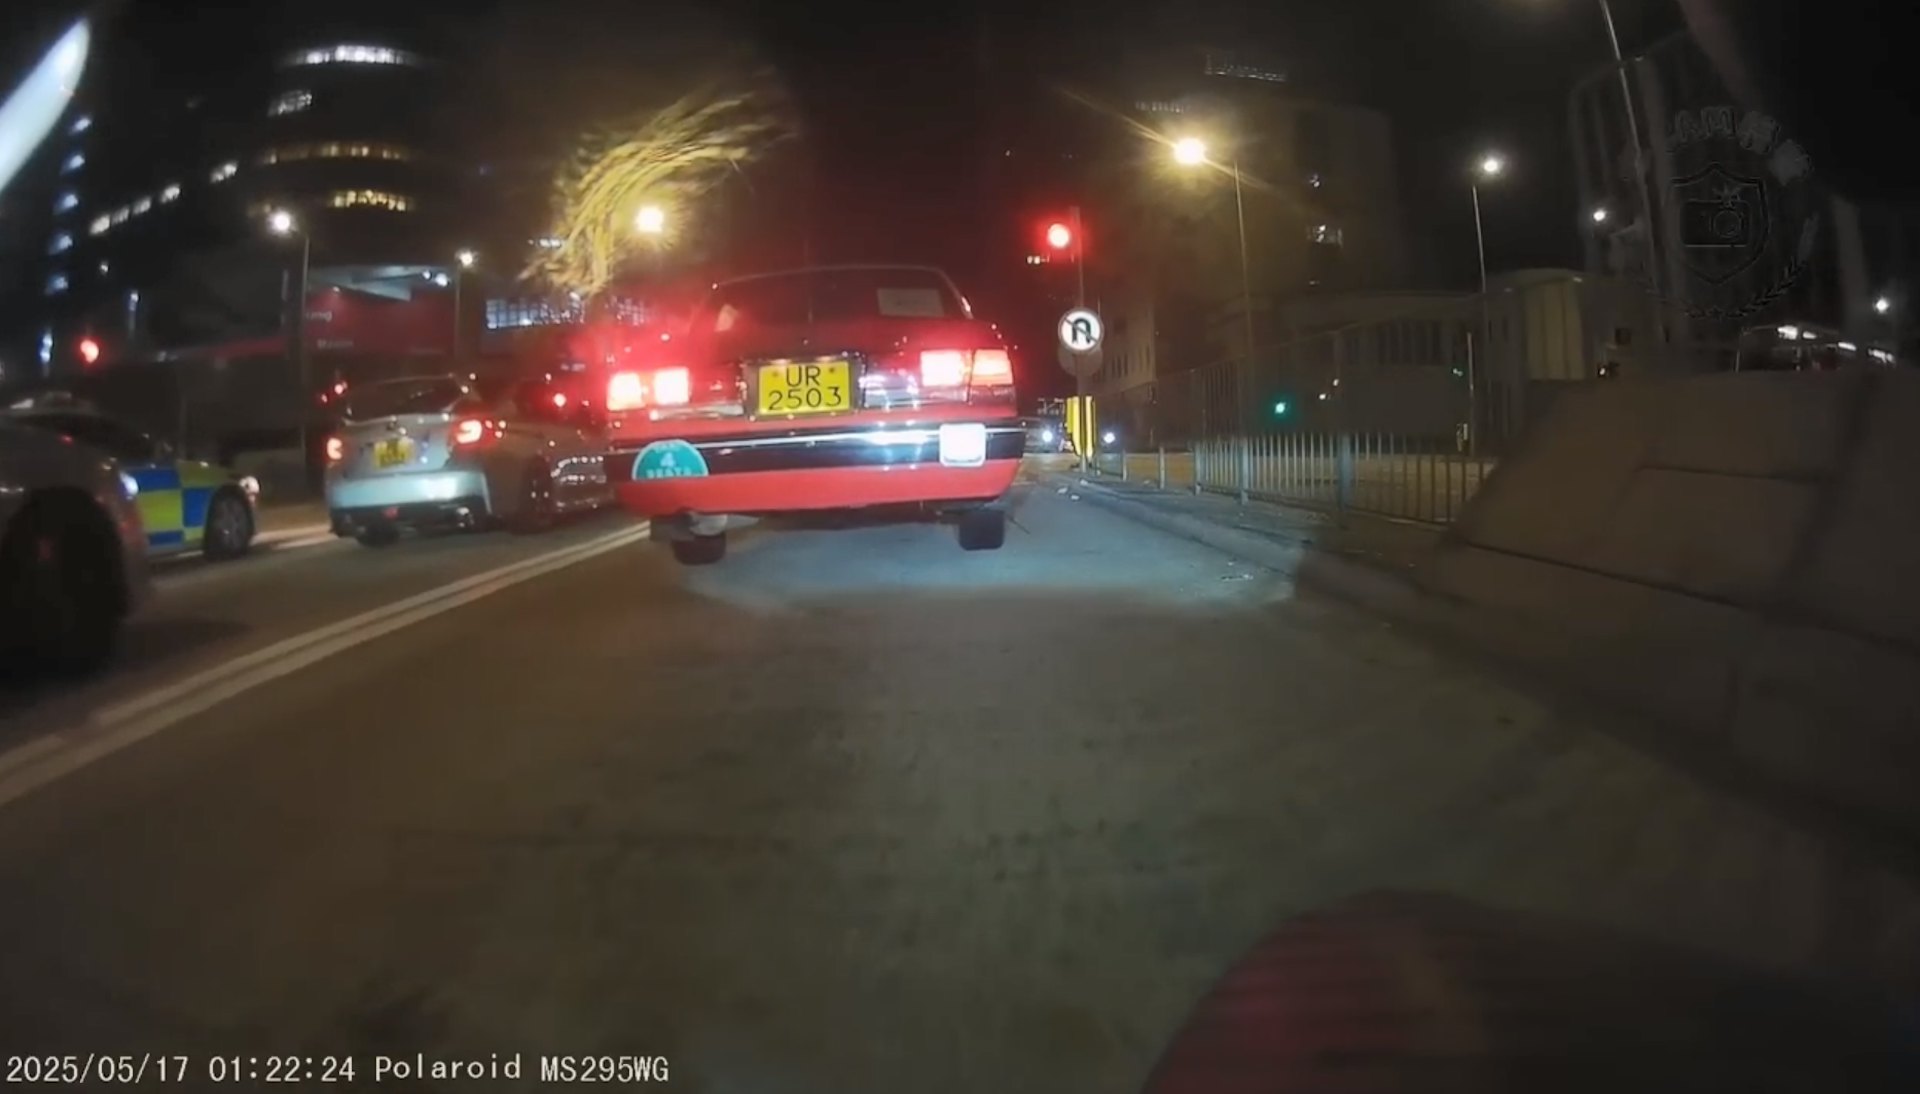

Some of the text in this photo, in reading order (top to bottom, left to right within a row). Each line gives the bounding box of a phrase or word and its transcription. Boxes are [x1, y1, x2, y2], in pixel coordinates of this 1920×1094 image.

[786, 365, 821, 388] UR
[768, 386, 842, 411] 2503
[660, 452, 675, 467] 4
